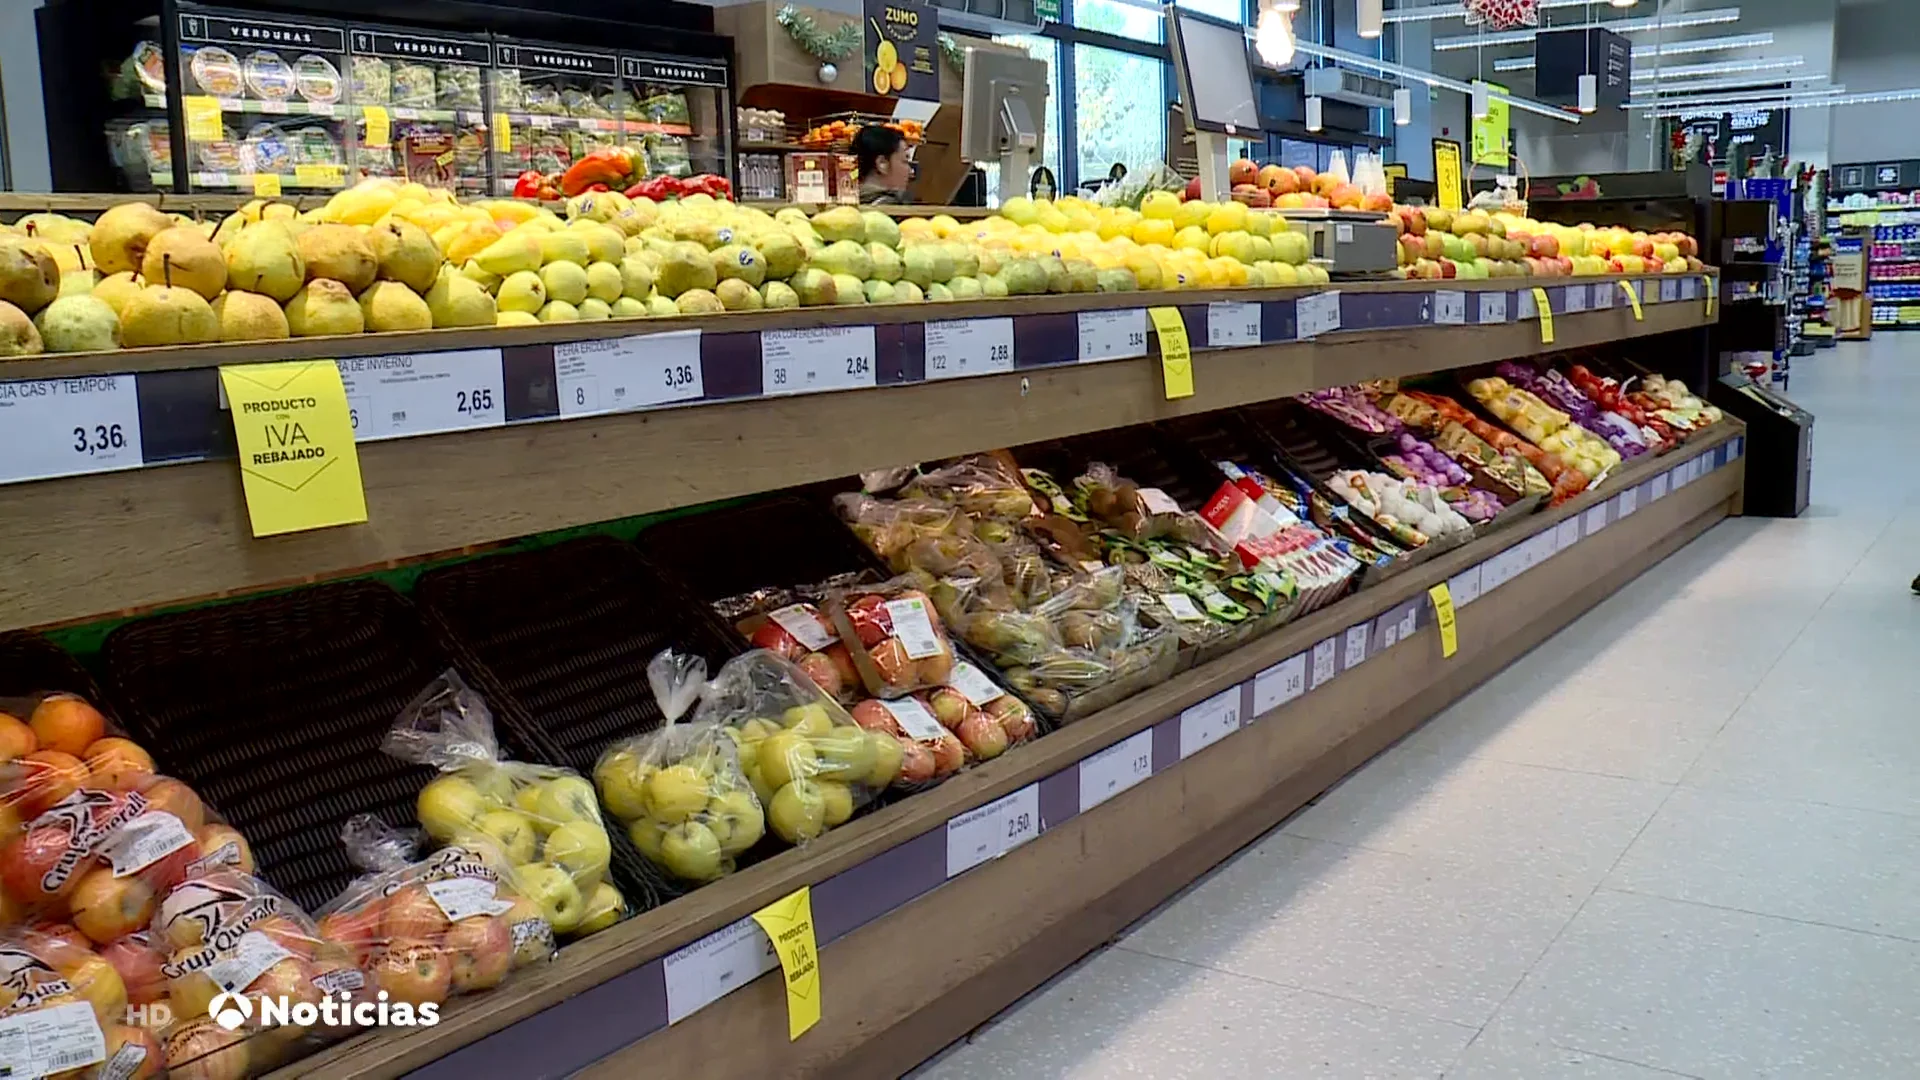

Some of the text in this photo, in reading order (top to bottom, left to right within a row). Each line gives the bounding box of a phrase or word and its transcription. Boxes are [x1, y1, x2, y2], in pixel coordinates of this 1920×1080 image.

[886, 8, 918, 26] ZUMO
[231, 26, 312, 43] VERDURAS
[394, 41, 462, 56] VERDURAS
[351, 358, 365, 372] DE
[366, 356, 413, 371] INVIERNO
[933, 355, 946, 369] 122
[773, 368, 787, 384] 38
[20, 382, 47, 398] CAS
[50, 382, 59, 395] Y
[63, 377, 117, 395] TEMPOR
[576, 387, 585, 406] 8
[243, 397, 317, 415] PRODUCTO
[264, 422, 311, 448] IVA
[253, 447, 326, 465] REBAJADO
[1008, 812, 1029, 838] 2,50
[778, 921, 809, 944] PRODUCTO
[161, 949, 216, 979] Grup
[790, 944, 809, 967] IVA
[789, 960, 815, 983] REBAJADO
